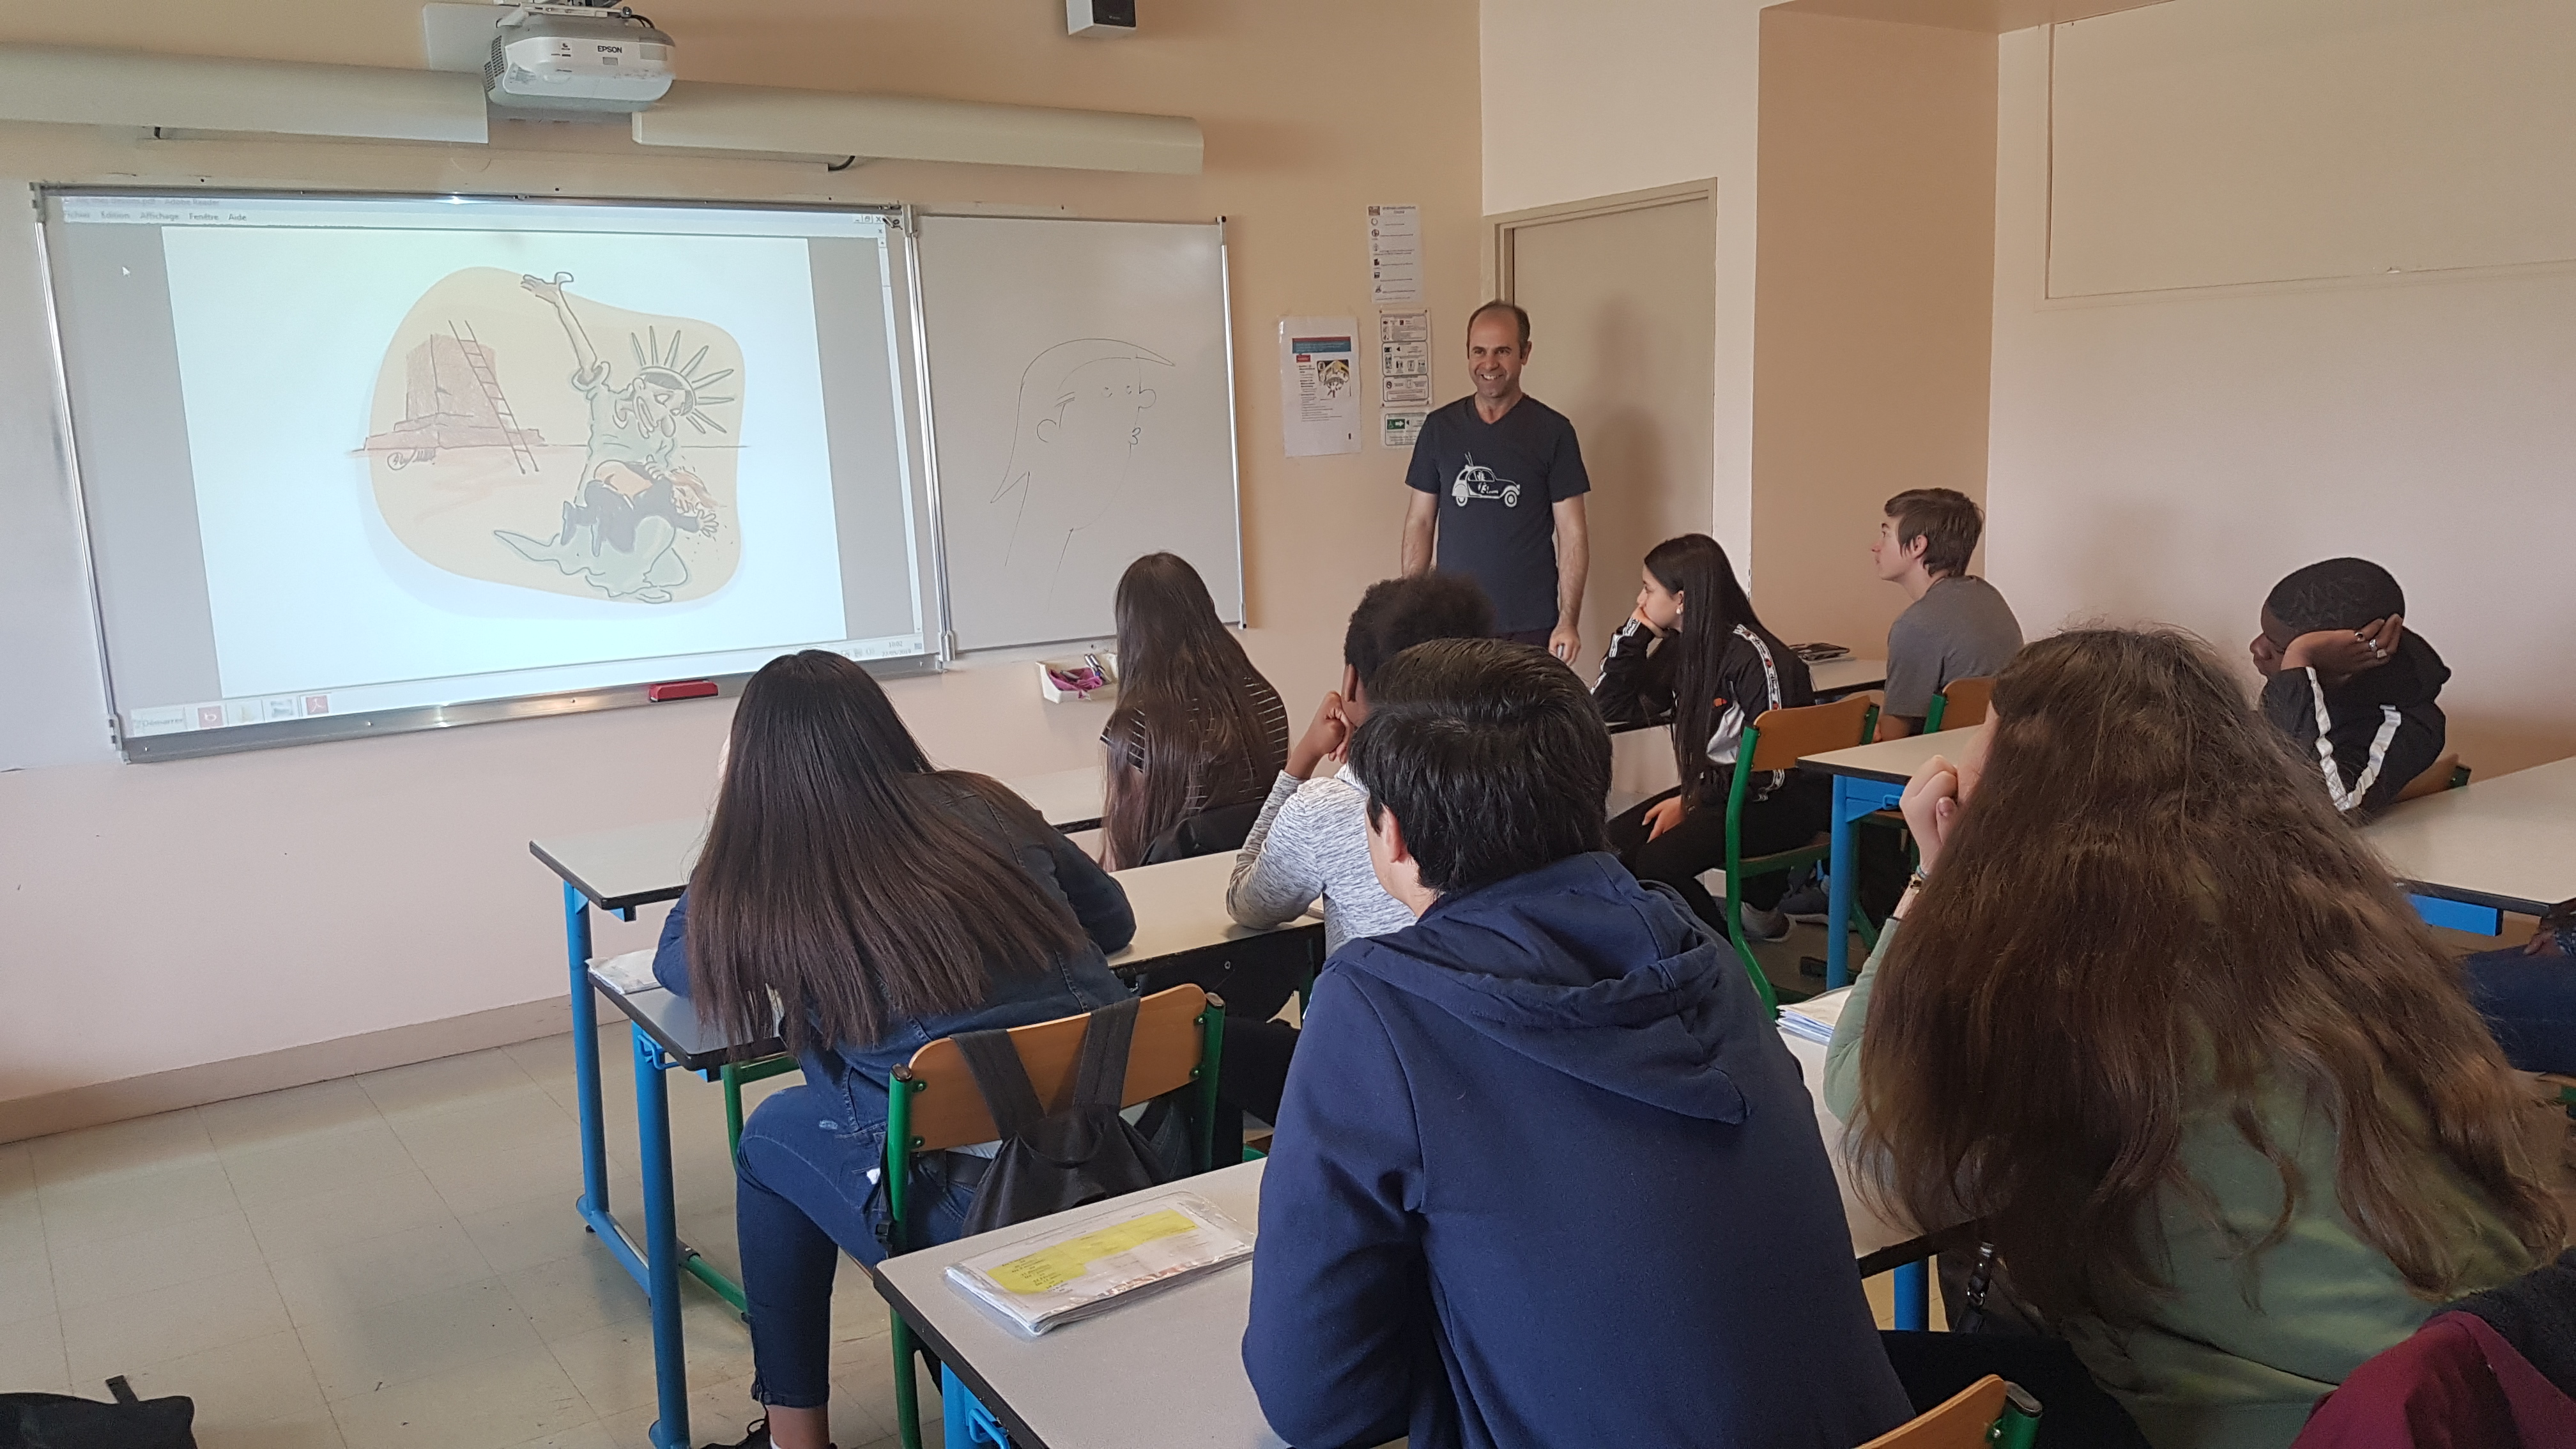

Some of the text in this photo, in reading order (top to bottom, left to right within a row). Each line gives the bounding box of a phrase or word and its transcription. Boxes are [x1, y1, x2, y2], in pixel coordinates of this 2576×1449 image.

[598, 45, 622, 54] EPSON
[139, 212, 180, 222] Affichage
[188, 213, 219, 221] Fenêtre
[228, 213, 247, 222] Aide
